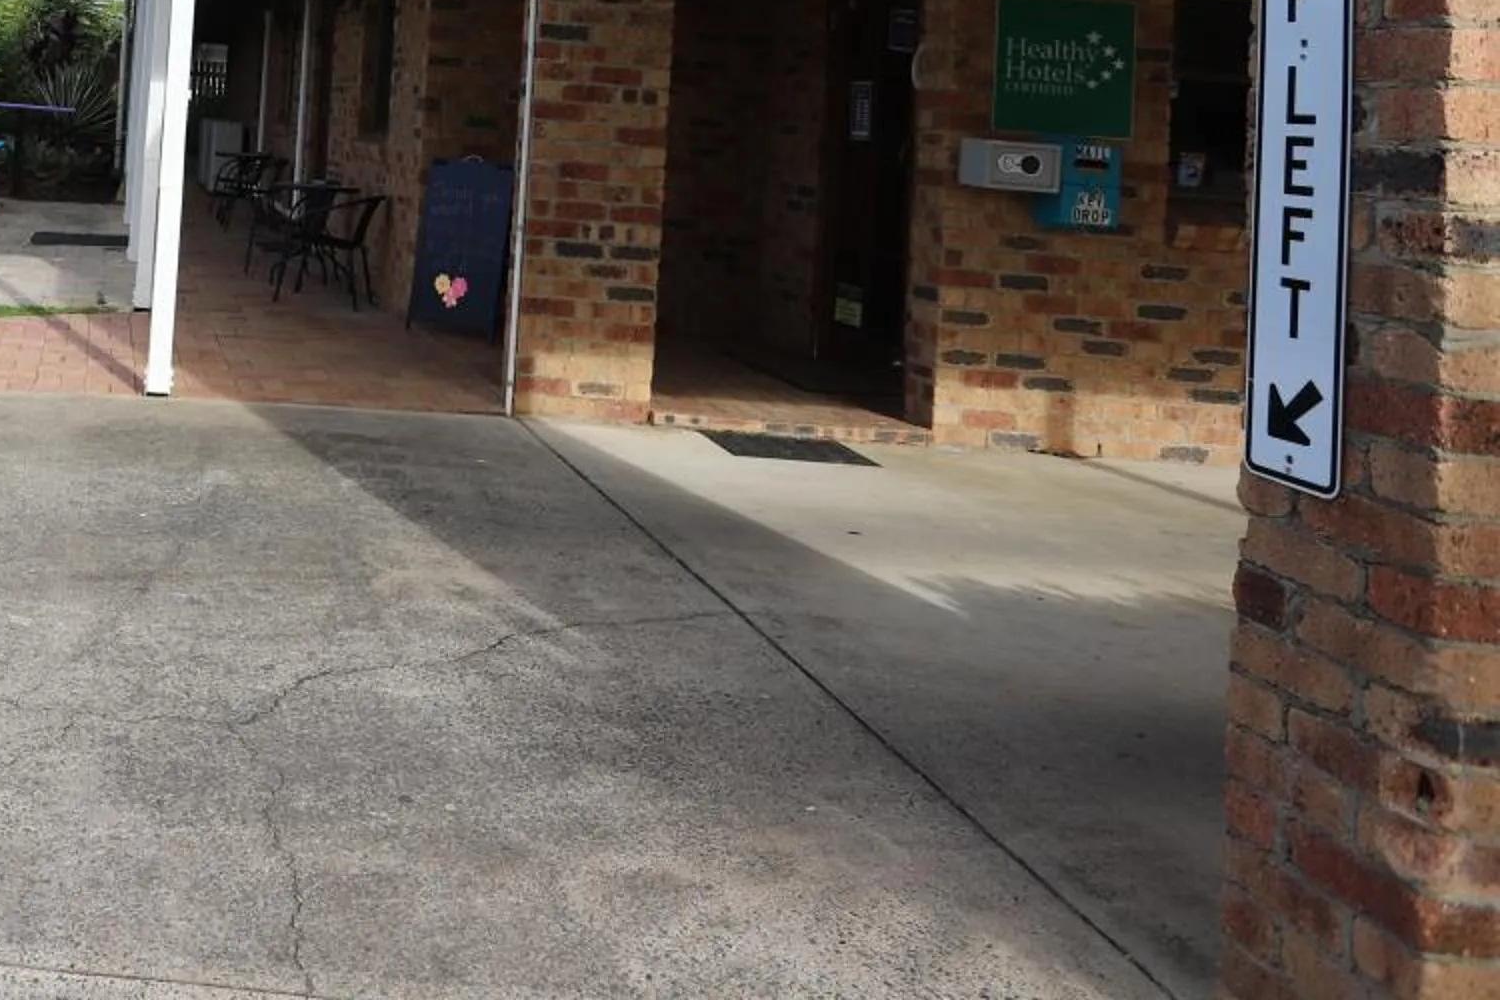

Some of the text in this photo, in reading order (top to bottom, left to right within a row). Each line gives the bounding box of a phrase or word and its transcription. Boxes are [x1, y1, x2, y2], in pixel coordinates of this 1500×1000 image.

[1006, 37, 1098, 63] Healthy
[1005, 60, 1085, 83] Hotels
[1279, 65, 1317, 340] LEFT
[1074, 208, 1109, 223] DROP
